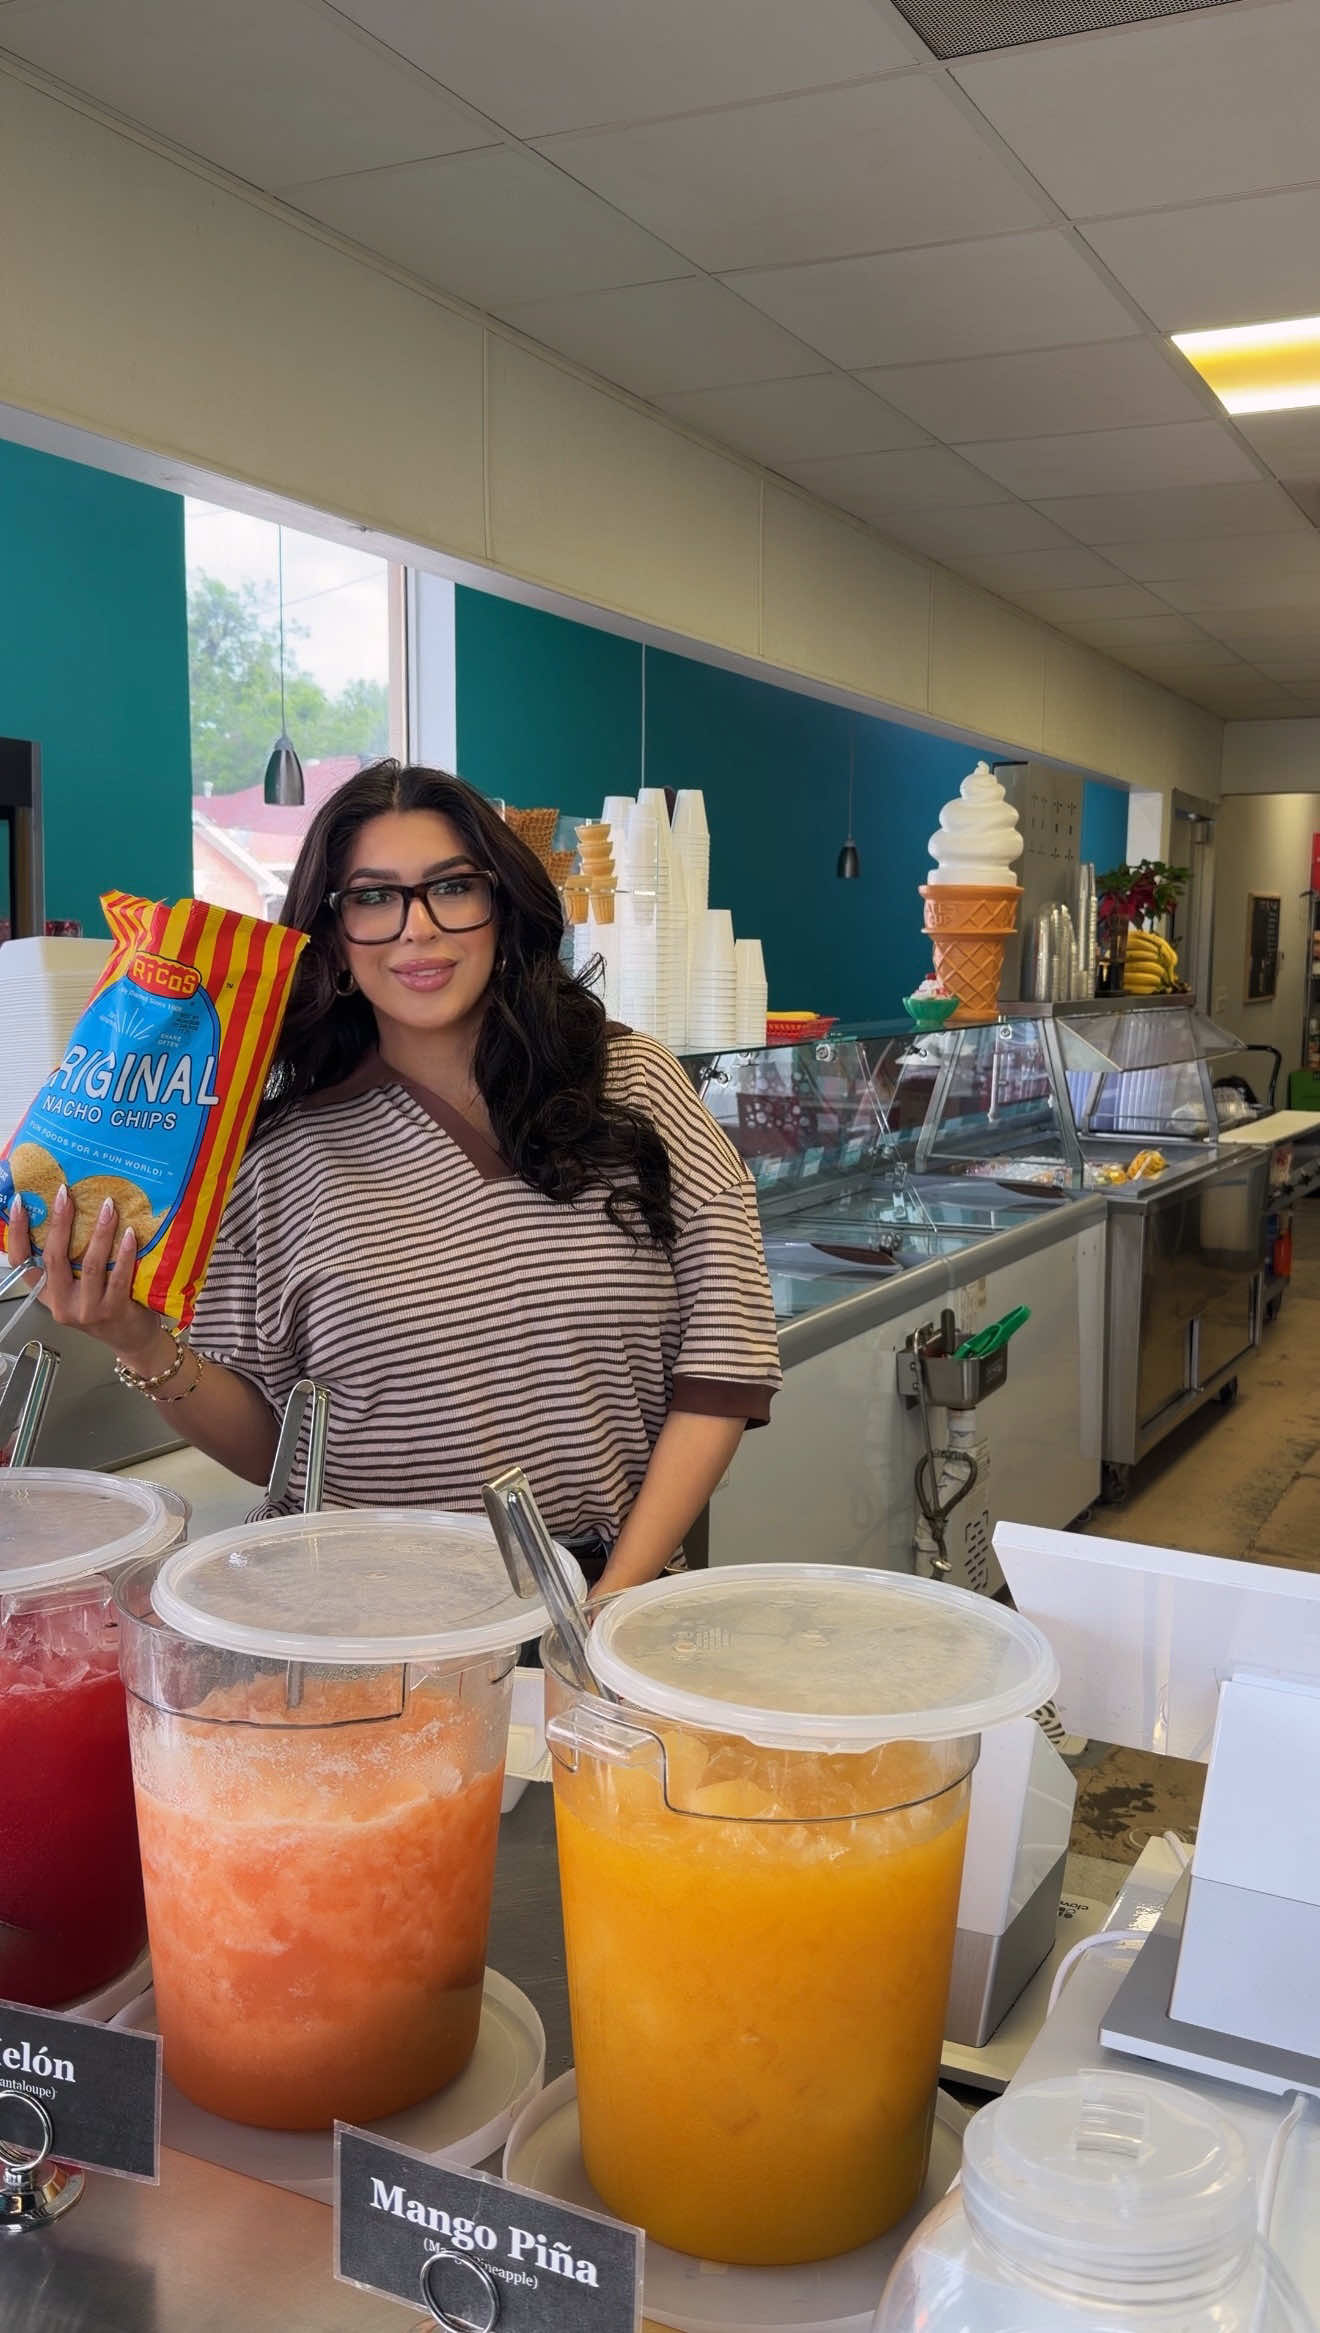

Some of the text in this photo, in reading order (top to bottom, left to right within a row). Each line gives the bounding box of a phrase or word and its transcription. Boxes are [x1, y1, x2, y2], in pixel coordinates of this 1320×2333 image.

[48, 1044, 219, 1105] RIGINAL
[42, 1094, 178, 1131] NACHO CHIPS
[41, 1126, 69, 1146] FOODS
[71, 1141, 91, 1155] FOR
[92, 1149, 100, 1158] A
[103, 1152, 122, 1164] FUN
[124, 1158, 163, 1177] WORLD!
[0, 2038, 77, 2083] elón
[0, 2079, 56, 2100] antaloupe)
[369, 2176, 600, 2288] Mango Piña
[474, 2256, 538, 2290] neapple)
